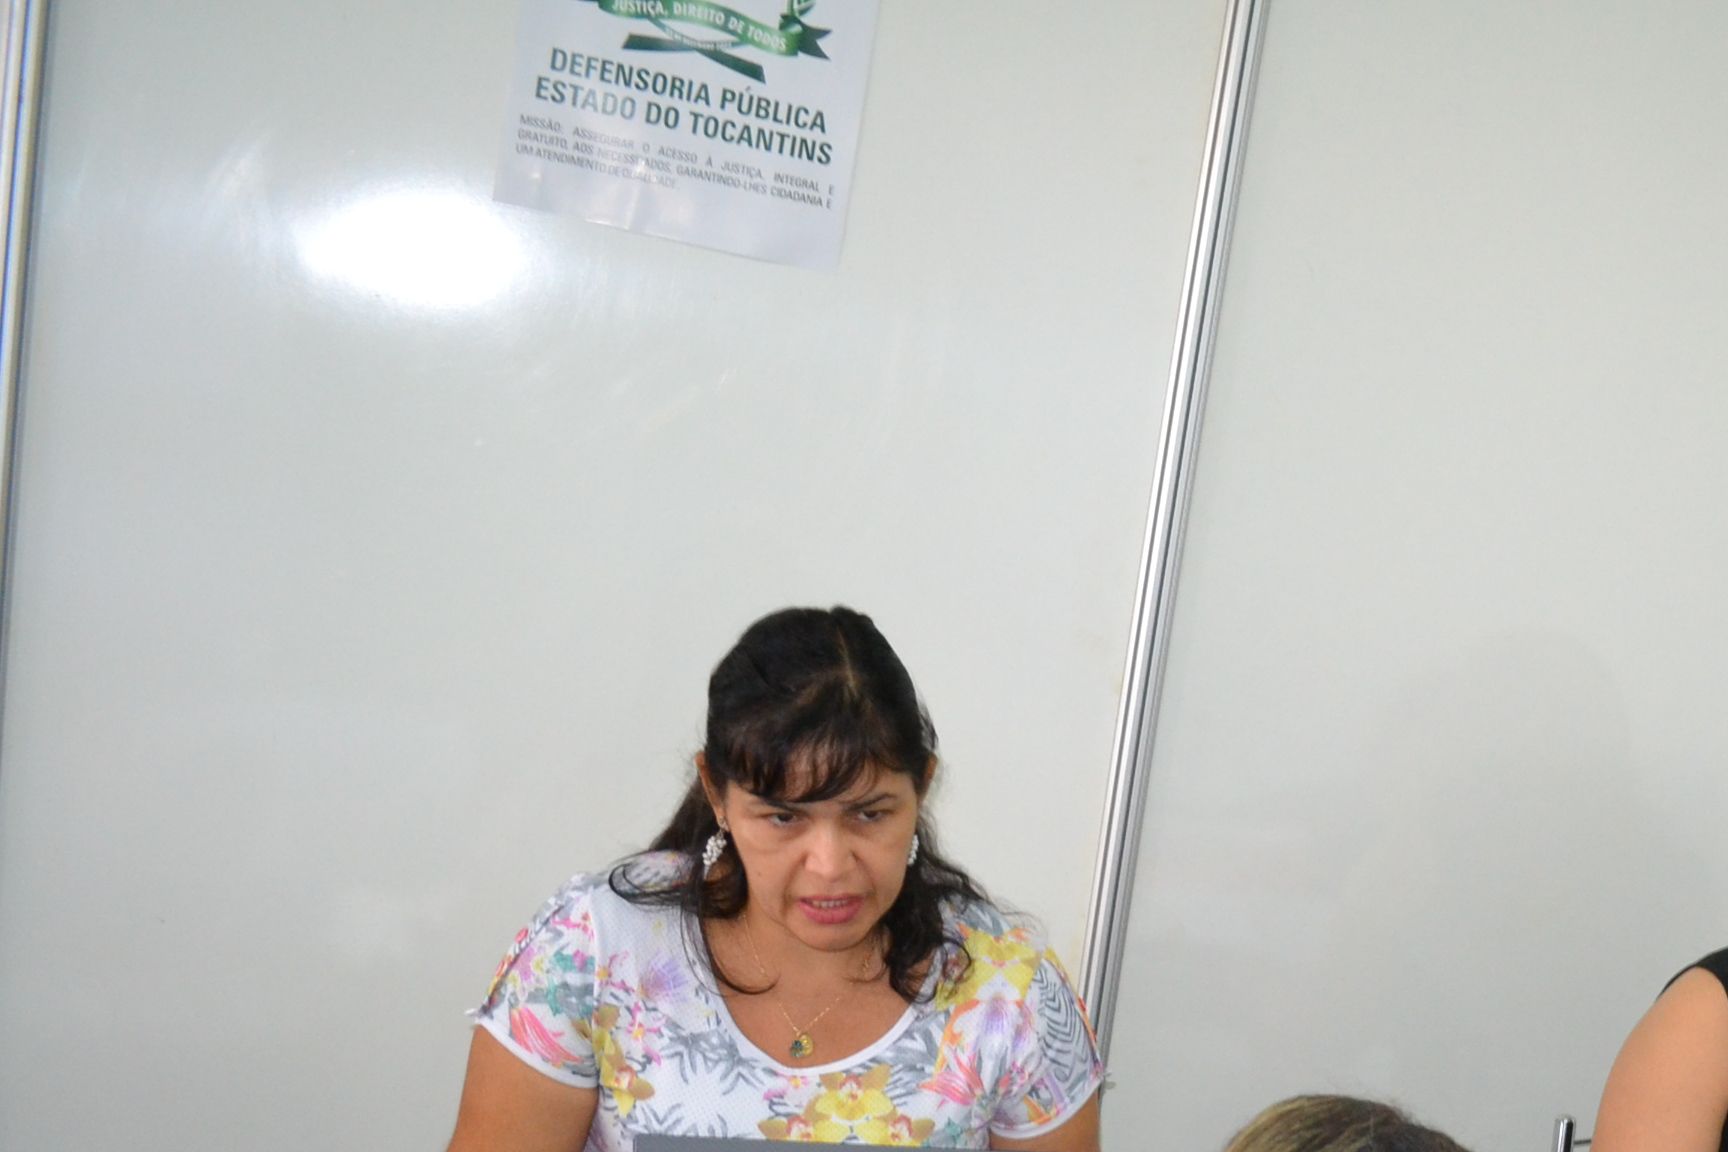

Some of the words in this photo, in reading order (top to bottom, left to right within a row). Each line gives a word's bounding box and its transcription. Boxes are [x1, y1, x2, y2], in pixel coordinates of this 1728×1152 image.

[728, 16, 744, 33] DE
[748, 25, 787, 50] TODOS
[536, 76, 637, 121] ESTADO
[645, 102, 680, 130] DO
[689, 111, 833, 166] TOCANTINS
[550, 47, 711, 107] DEFENSORIA
[720, 85, 827, 134] PÚBLICA
[572, 141, 594, 155] AOS
[770, 186, 824, 207] CIDADANIA
[658, 145, 698, 163] ACESSO
[773, 171, 820, 193] INTEGRAL
